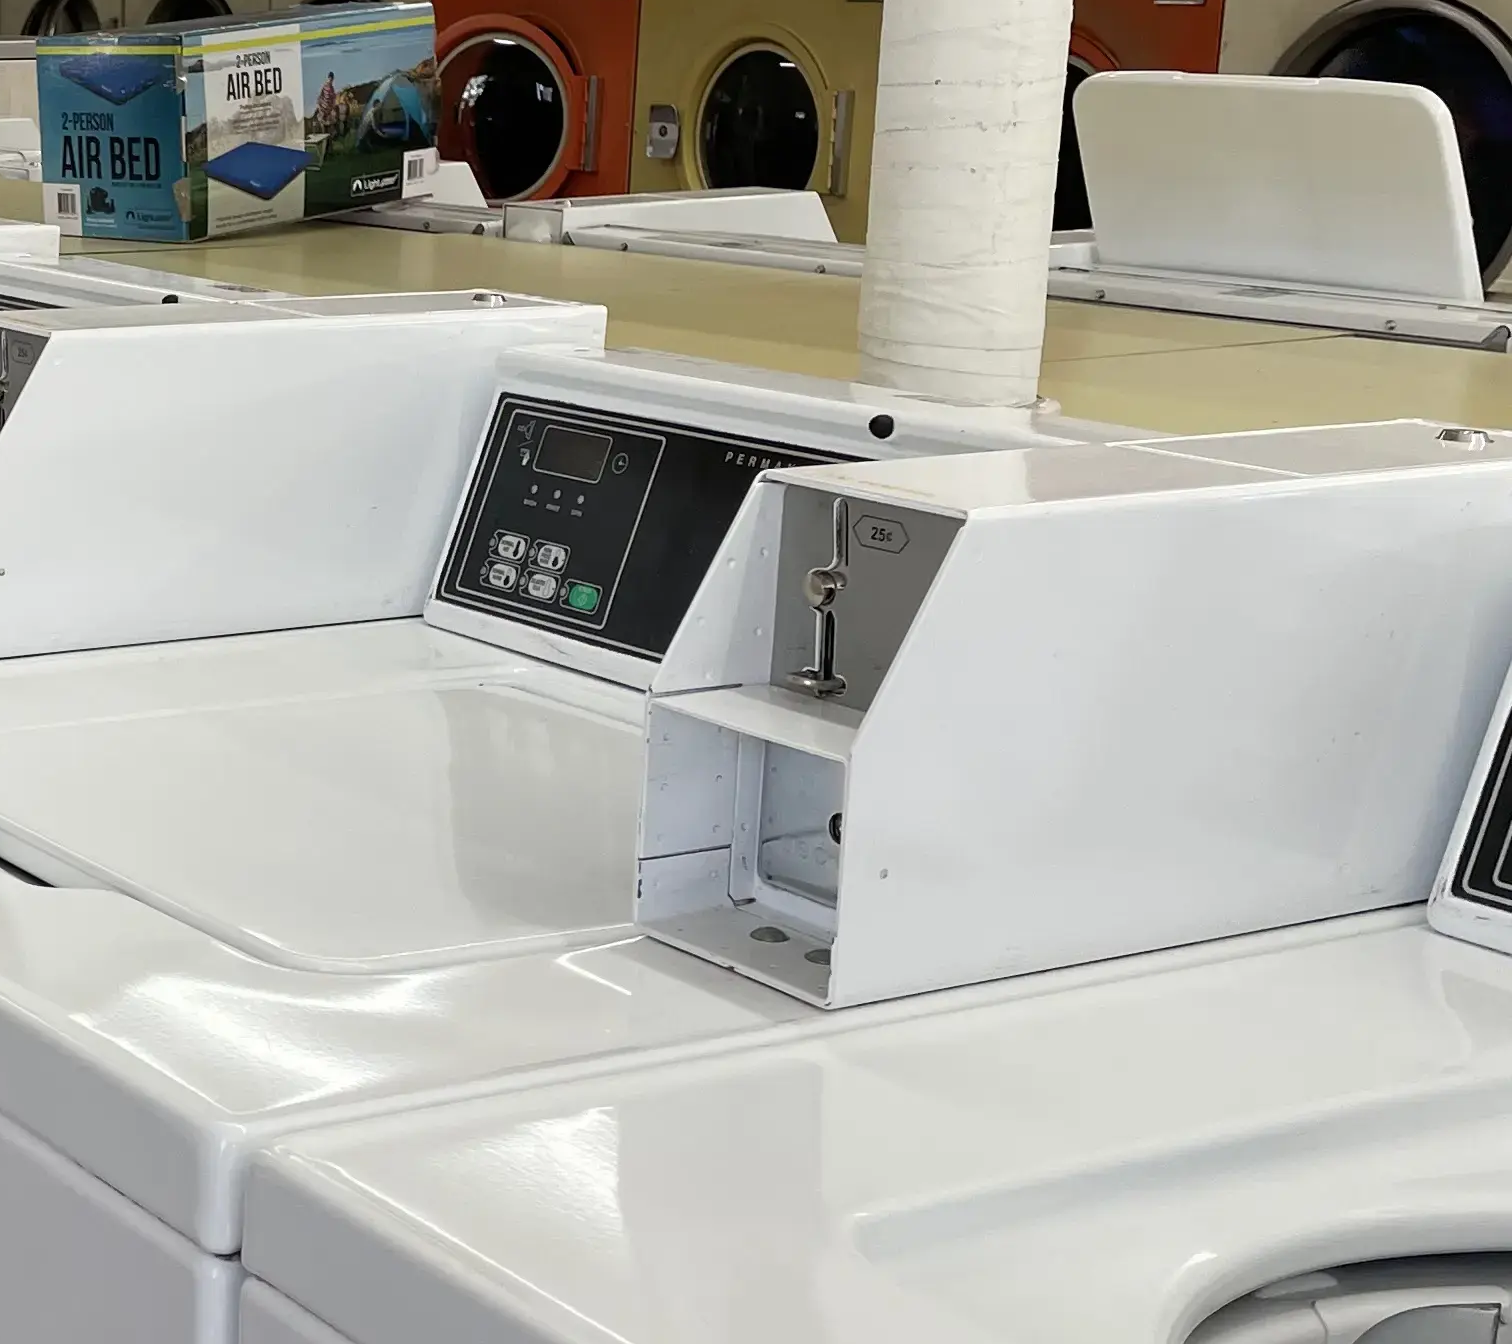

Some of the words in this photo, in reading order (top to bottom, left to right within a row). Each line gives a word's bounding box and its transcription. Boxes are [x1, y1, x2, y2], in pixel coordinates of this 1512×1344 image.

[235, 50, 271, 69] 2-PERSON
[226, 71, 251, 102] AIR
[254, 67, 282, 97] BED
[61, 112, 114, 132] 2-PERSON
[61, 135, 102, 179] AIR
[109, 136, 161, 181] BED
